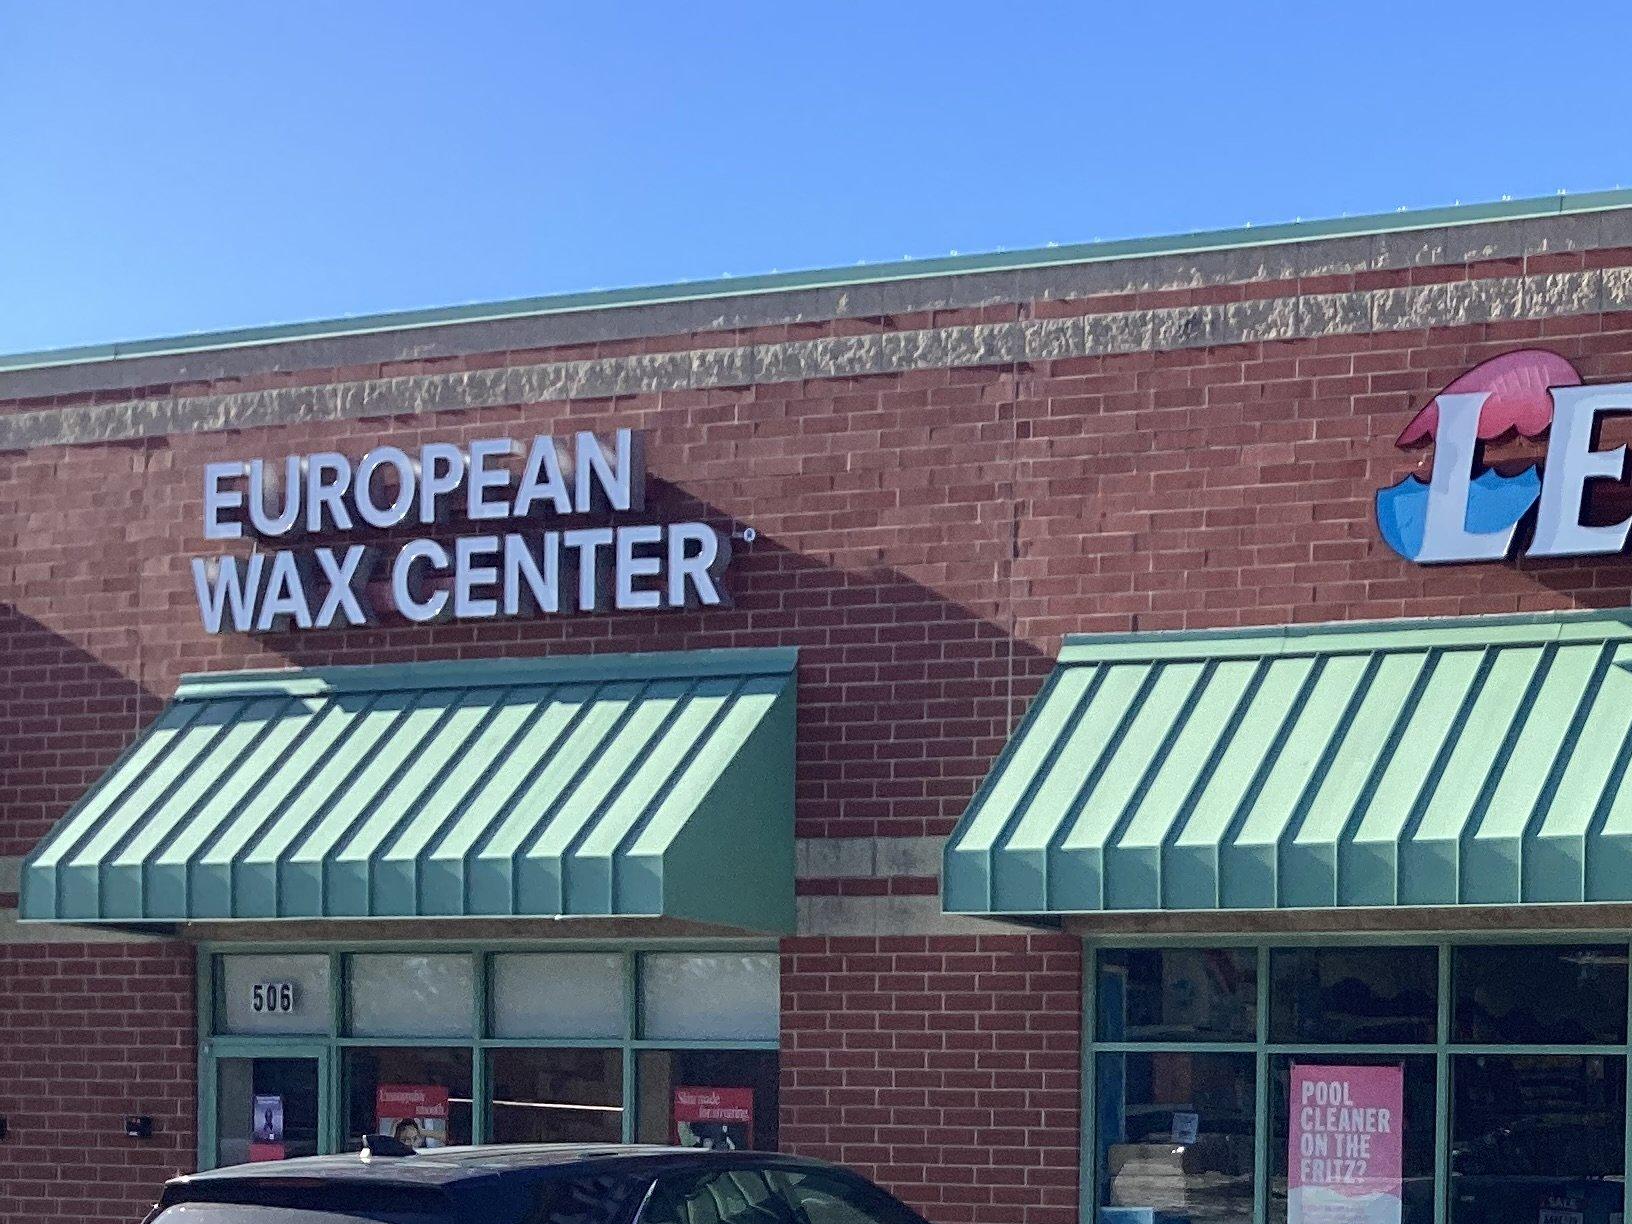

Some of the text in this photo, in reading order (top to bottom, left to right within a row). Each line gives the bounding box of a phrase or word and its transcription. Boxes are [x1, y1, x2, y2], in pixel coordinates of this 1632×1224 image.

[203, 427, 636, 541] EUROPEAN
[192, 521, 722, 635] WAX CENTER
[253, 984, 291, 1012] 506
[1301, 1080, 1354, 1106] POOL
[1300, 1106, 1391, 1133] CLEANER
[1300, 1132, 1371, 1159] ON THE
[1300, 1158, 1367, 1184] FRITZ?
